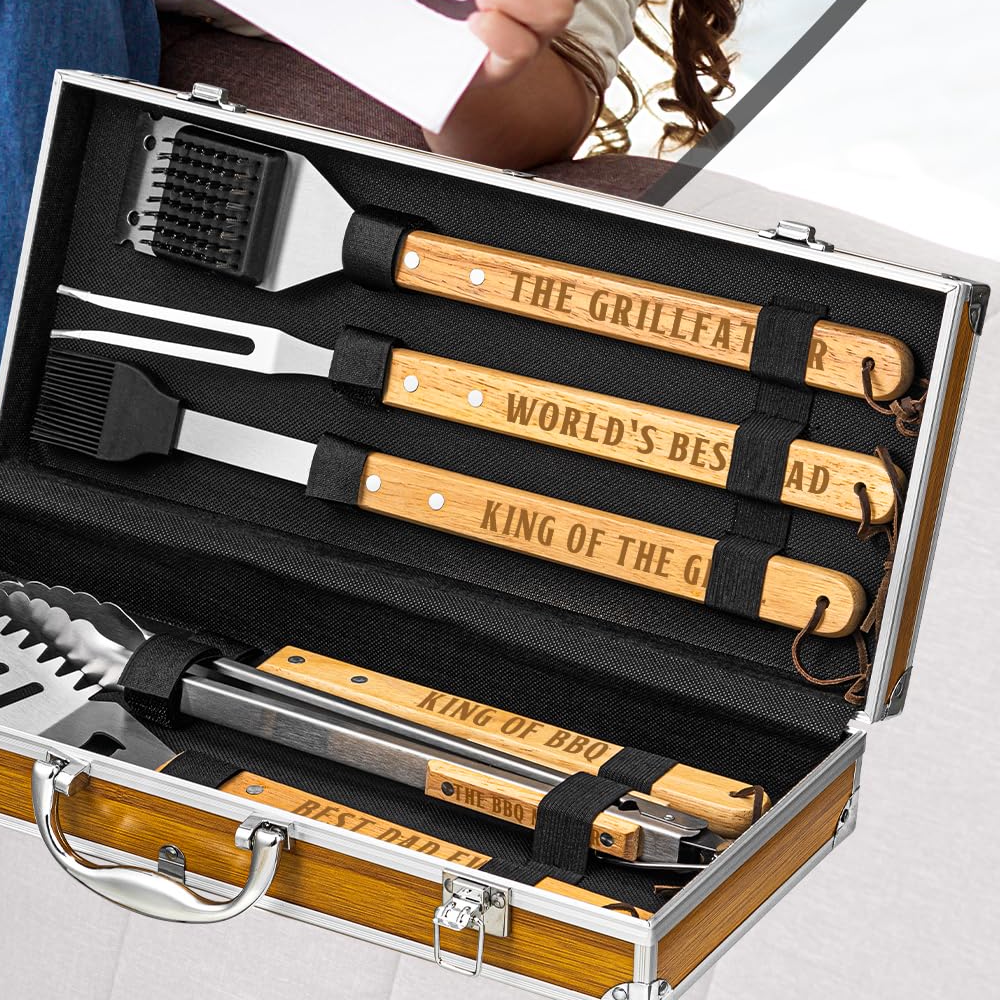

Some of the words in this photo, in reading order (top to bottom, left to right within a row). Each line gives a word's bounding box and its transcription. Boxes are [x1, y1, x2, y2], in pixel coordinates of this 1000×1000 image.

[511, 270, 576, 314] THE
[589, 290, 828, 371] GRILLFATR
[506, 393, 657, 455] WORLD'S
[668, 432, 730, 471] BES
[785, 461, 830, 495] AD
[480, 500, 556, 546] KING
[567, 524, 606, 557] OF
[617, 535, 675, 577] THE
[417, 691, 497, 727] KING
[500, 716, 544, 739] OF
[544, 730, 609, 762] BBQ
[291, 799, 376, 832] BEST
[453, 784, 487, 808] THE
[492, 797, 524, 822] BBQ
